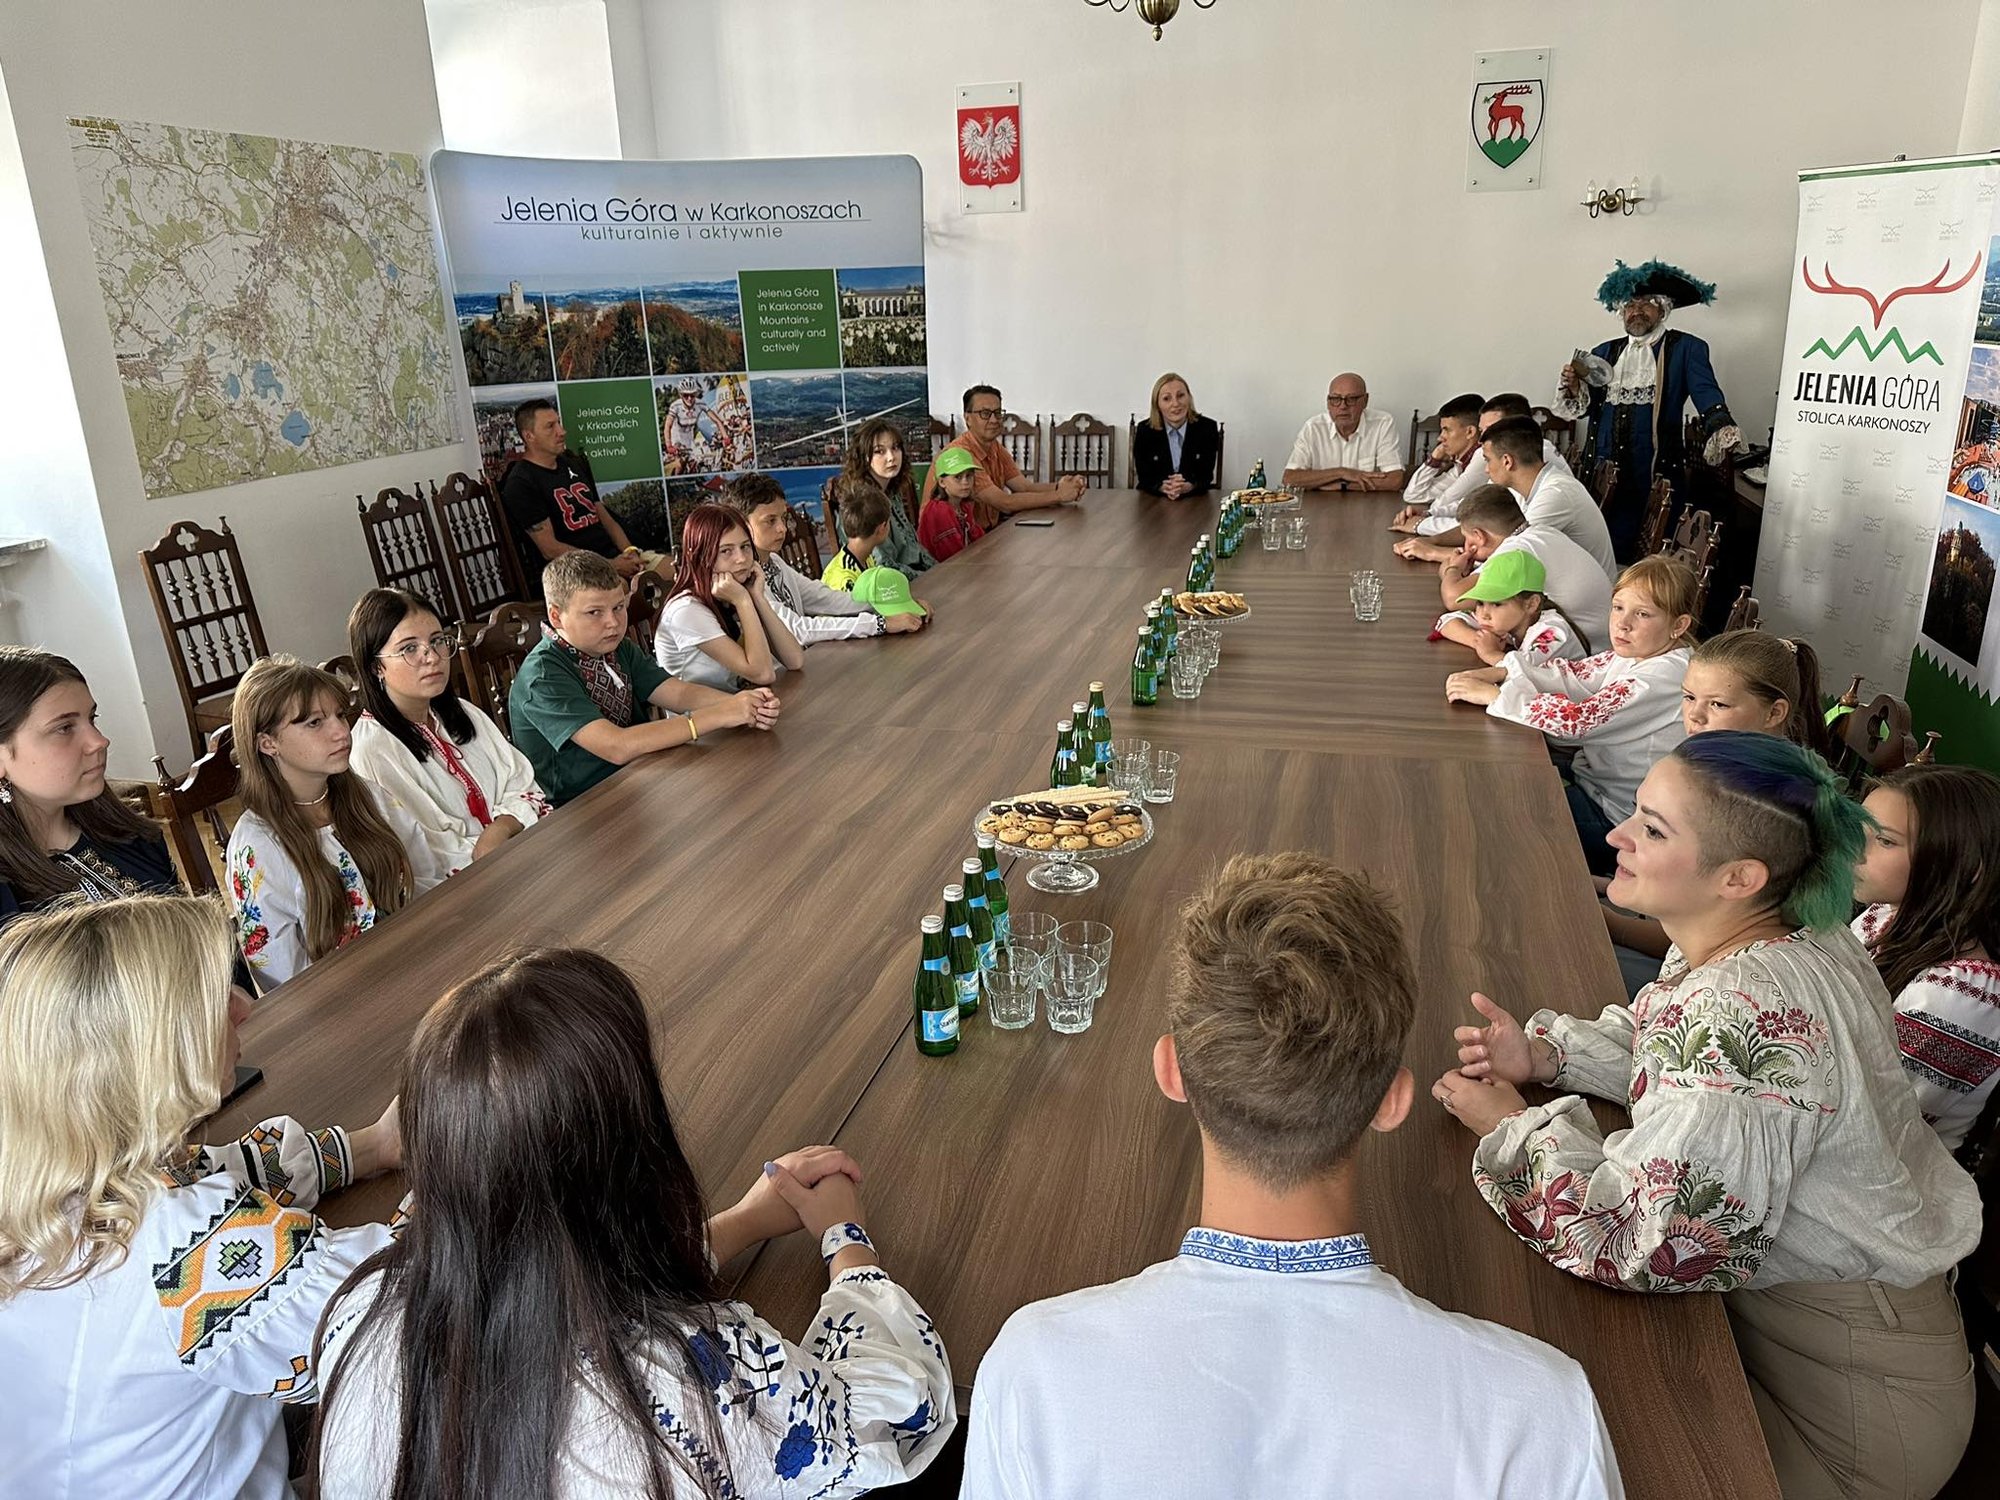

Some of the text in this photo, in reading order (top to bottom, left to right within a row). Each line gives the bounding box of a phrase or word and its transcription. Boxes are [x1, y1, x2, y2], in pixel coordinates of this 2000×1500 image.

[501, 195, 862, 222] Jelenia Góra w Karkonoszach
[581, 224, 783, 242] kulturalnie i aktywnie
[756, 287, 820, 298] Jelenia Góra
[758, 302, 824, 311] in Karkonosze
[759, 316, 810, 325] Mountains
[760, 328, 827, 339] culturally and
[762, 343, 800, 352] actively
[1793, 372, 1940, 412] JELENIA GÓRA
[576, 405, 640, 418] Jelenia Góra
[1797, 410, 1931, 434] STOLICA KARKONOSZY
